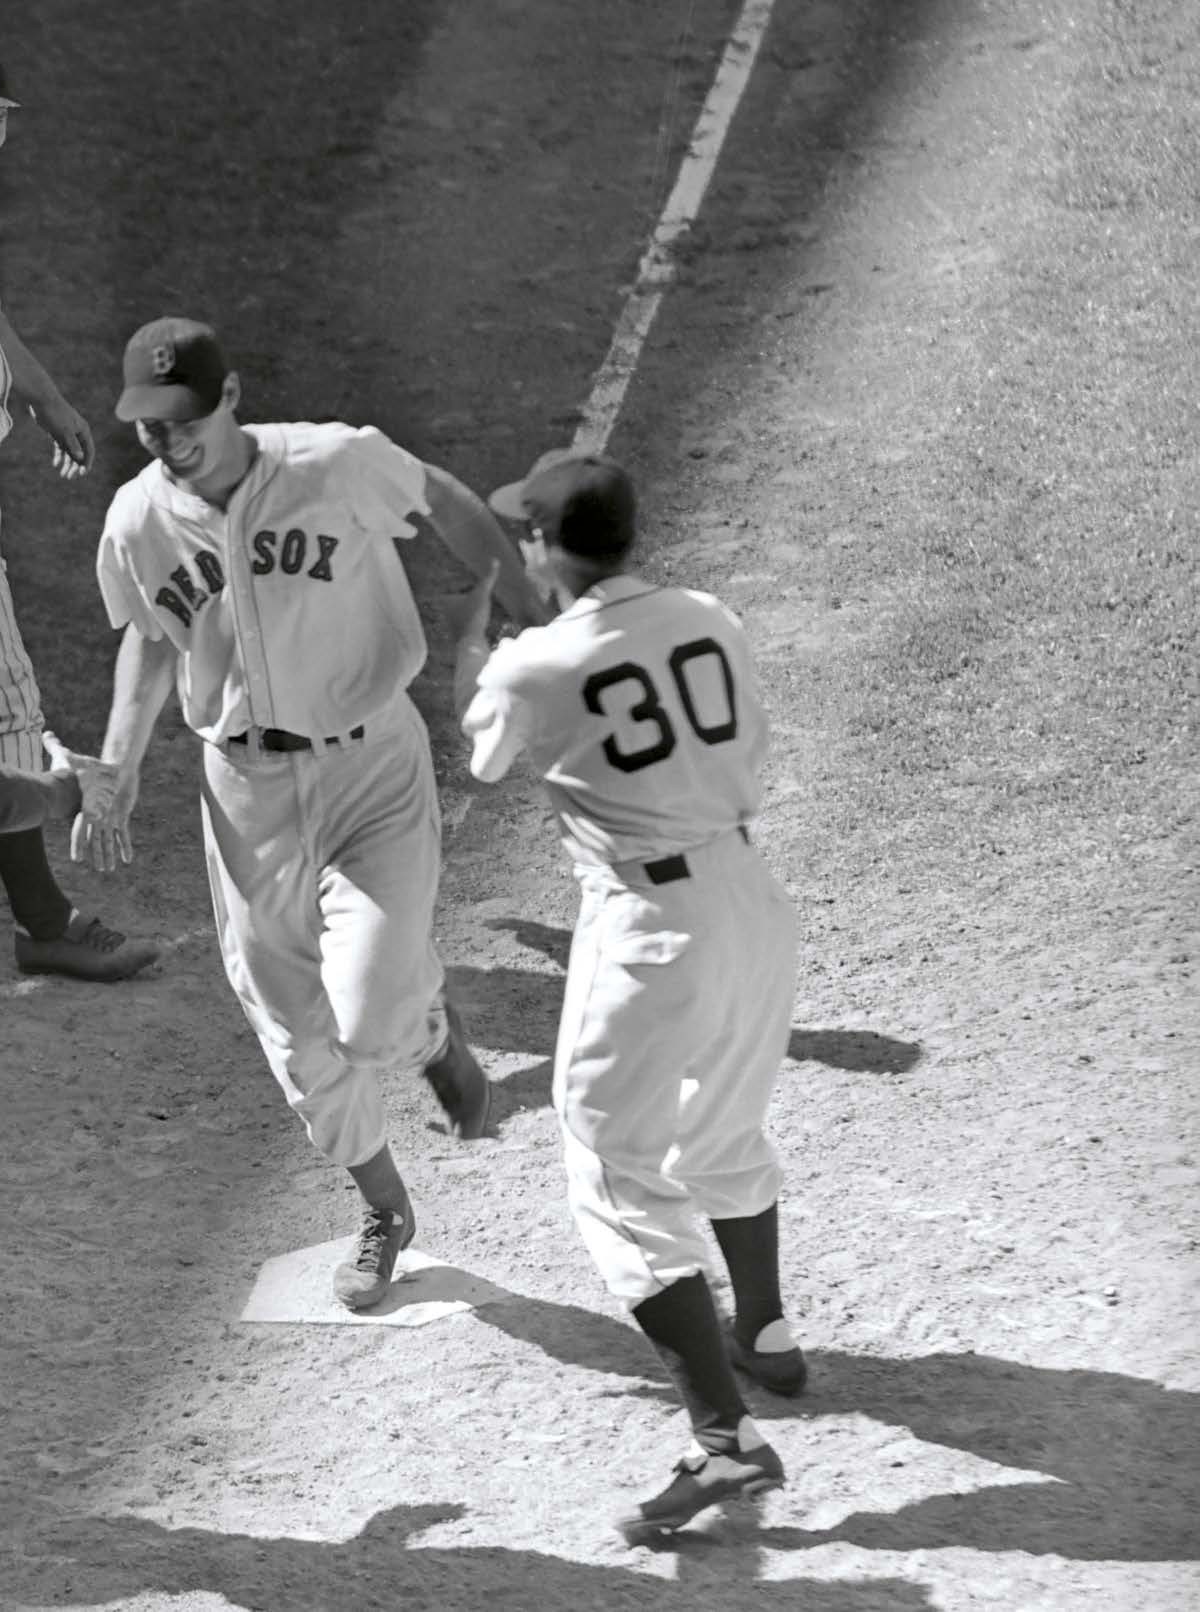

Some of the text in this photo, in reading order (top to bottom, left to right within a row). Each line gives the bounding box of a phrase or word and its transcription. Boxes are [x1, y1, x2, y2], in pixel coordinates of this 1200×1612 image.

[153, 345, 176, 375] B
[155, 528, 338, 628] RED SOX
[582, 637, 737, 773] 30
